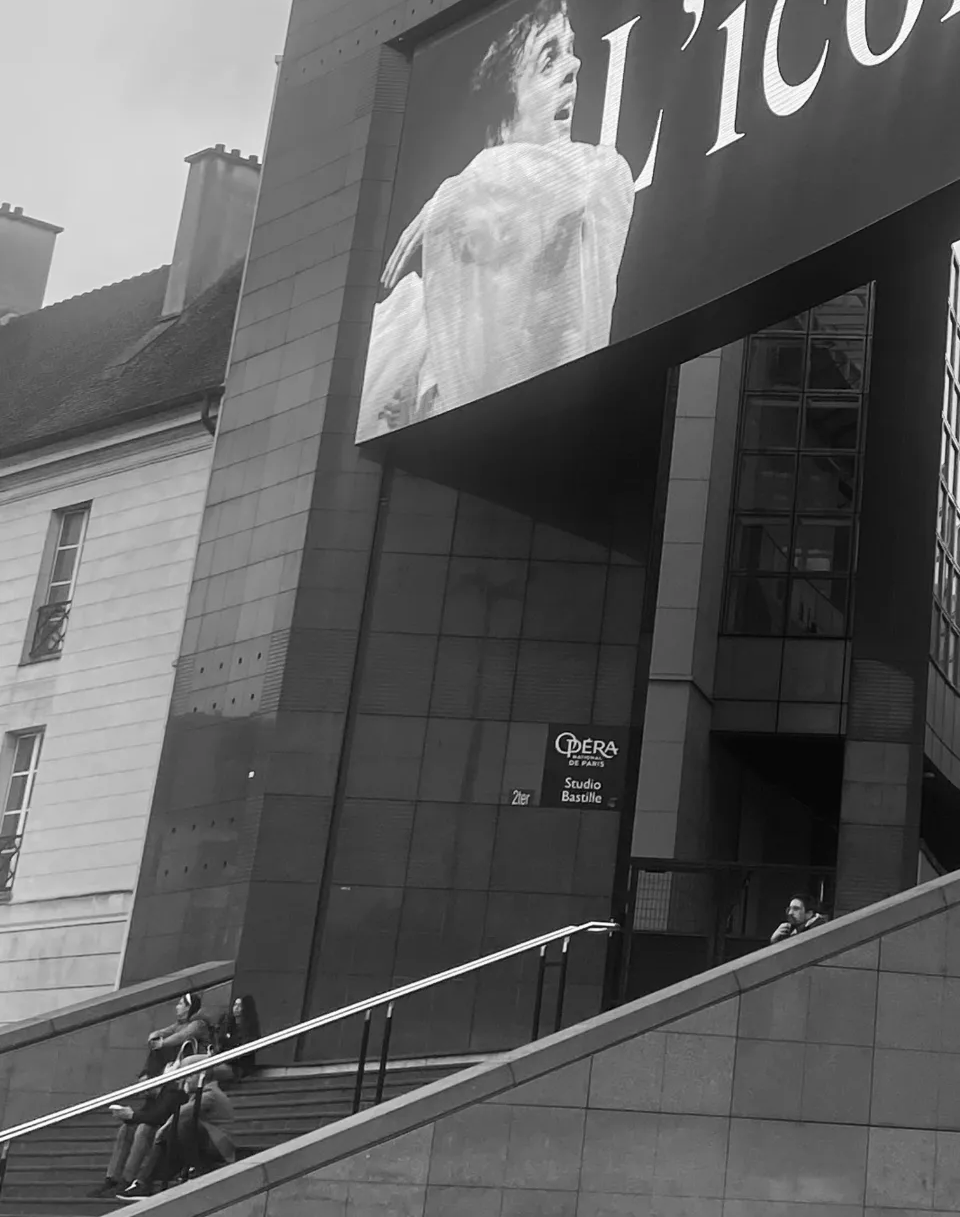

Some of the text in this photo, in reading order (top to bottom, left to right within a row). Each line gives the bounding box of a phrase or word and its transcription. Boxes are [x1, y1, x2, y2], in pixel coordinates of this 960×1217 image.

[555, 731, 619, 759] OPÉRA
[568, 759, 605, 768] DE PARIS
[564, 776, 602, 790] Studio
[511, 789, 531, 805] 2ter
[561, 790, 602, 804] Bastille
